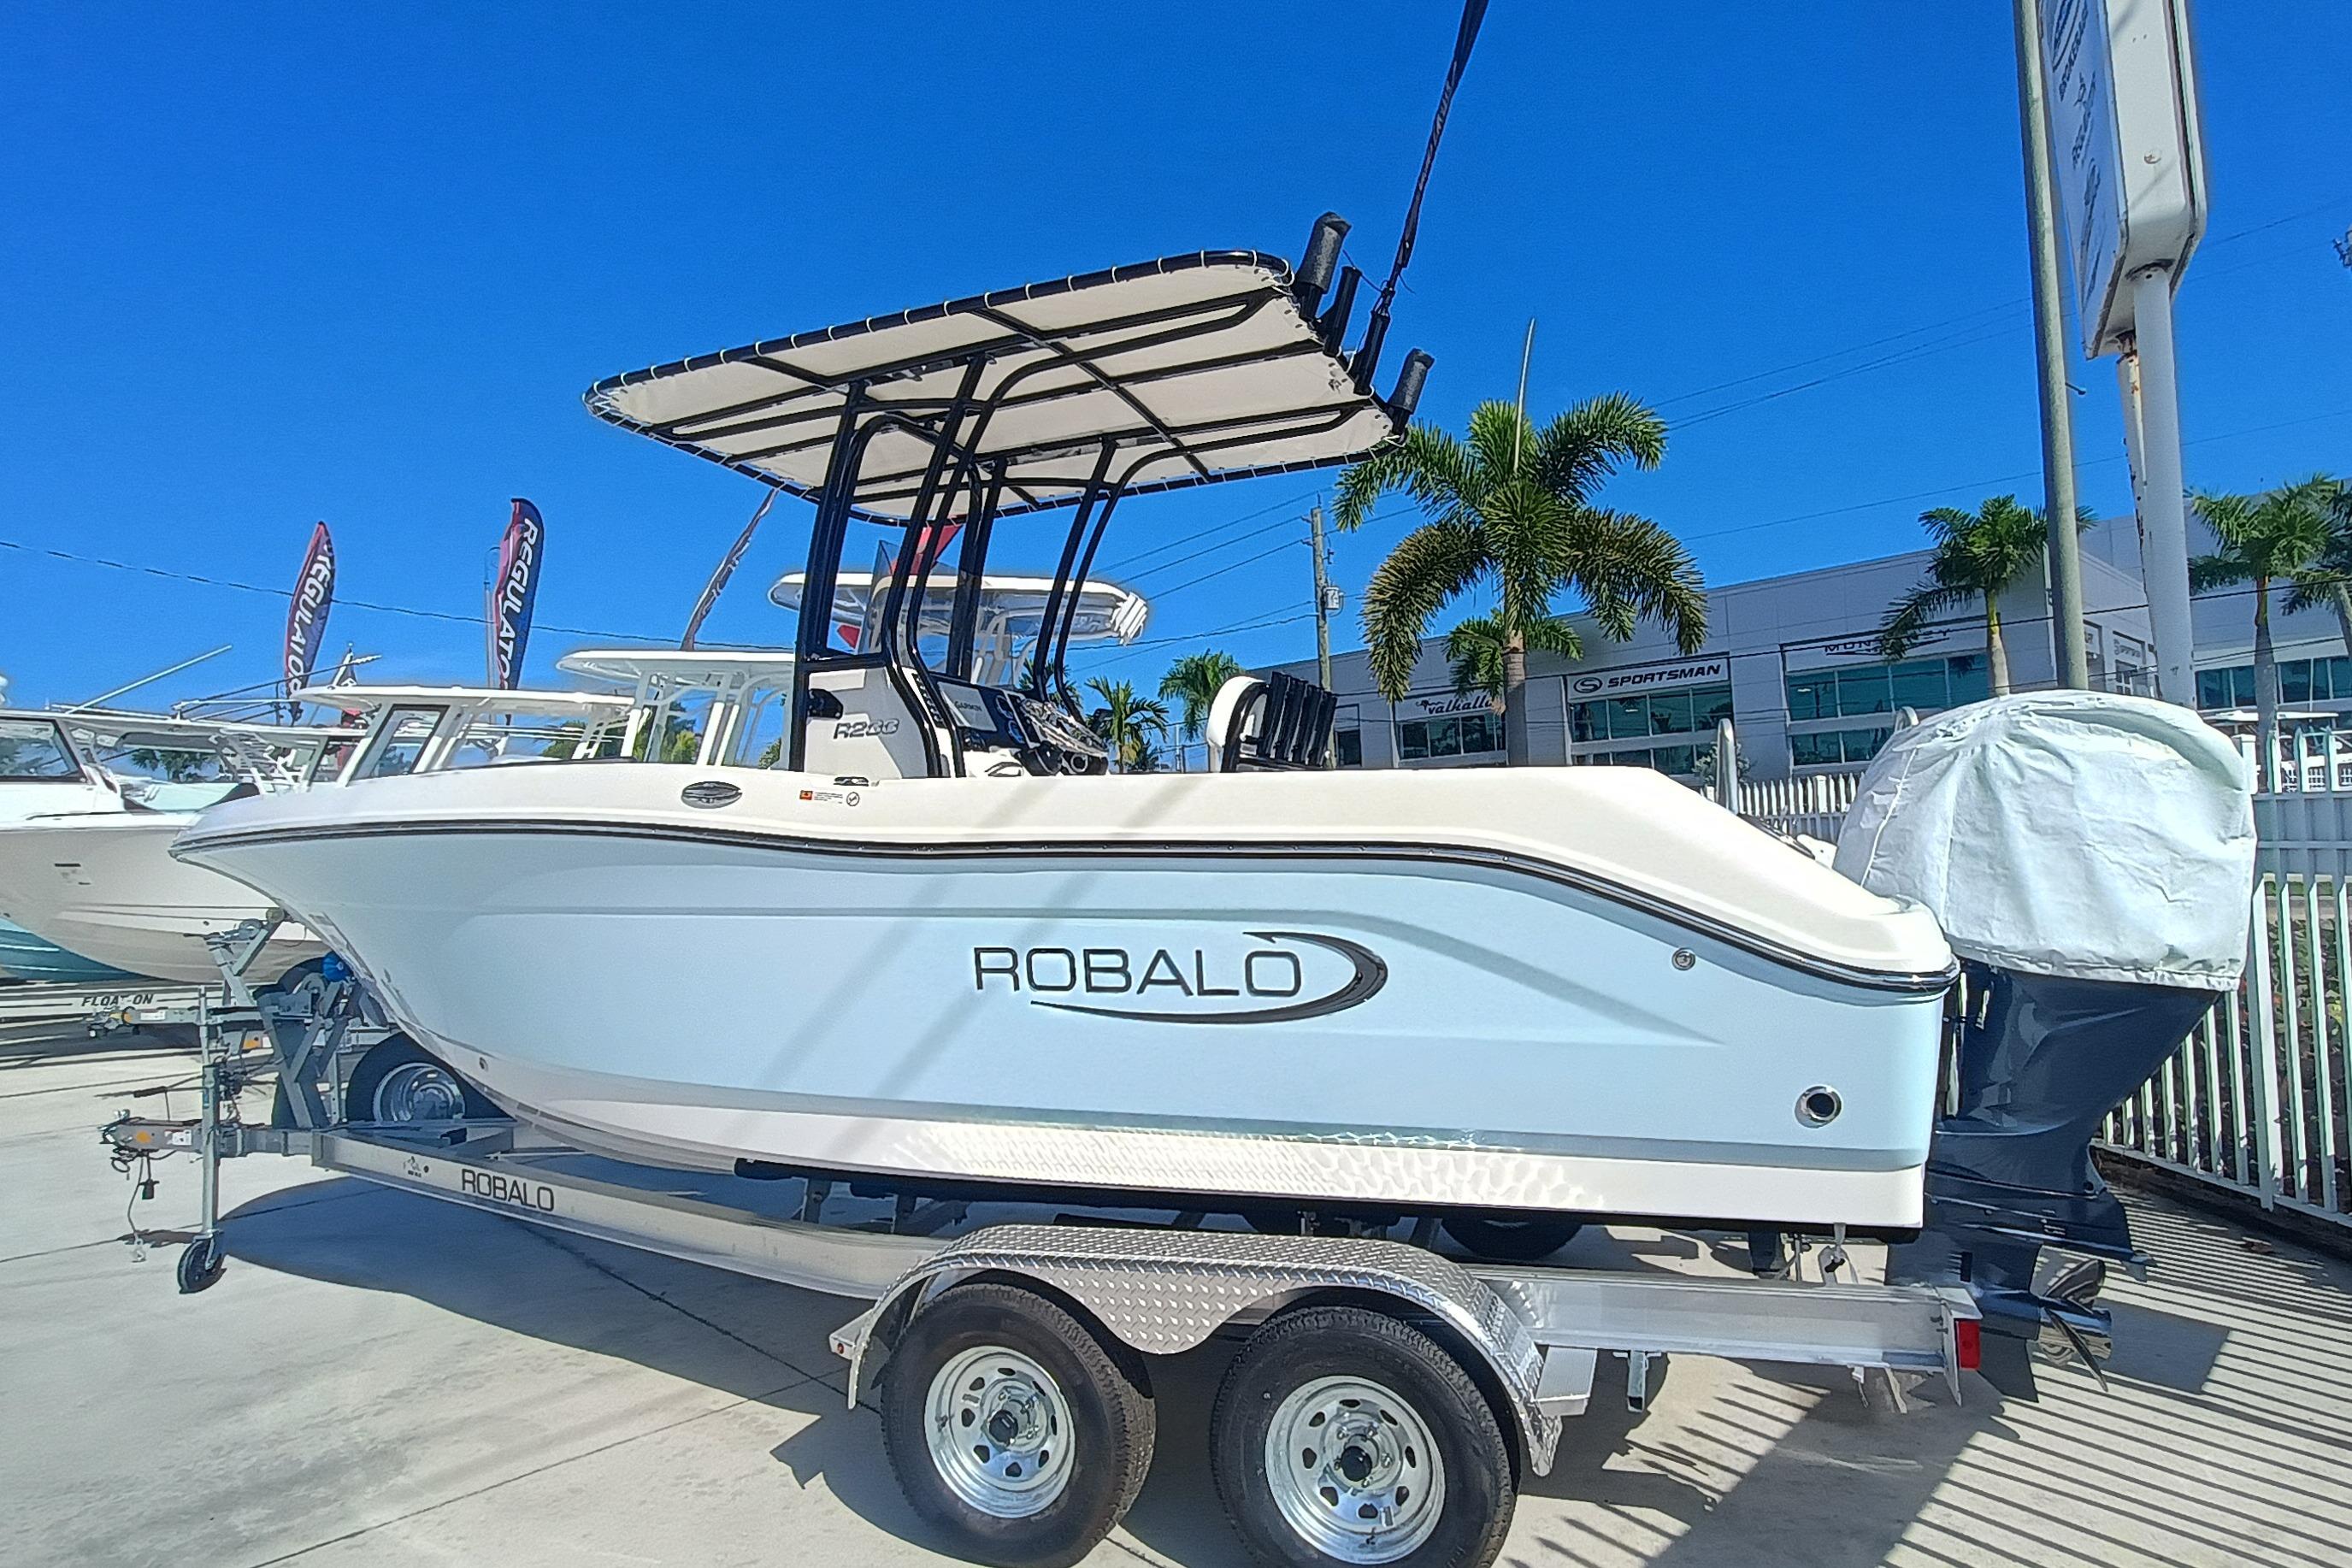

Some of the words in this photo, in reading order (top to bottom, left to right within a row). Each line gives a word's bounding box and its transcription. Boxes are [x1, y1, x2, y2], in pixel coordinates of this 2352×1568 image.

[498, 517, 539, 689] REGULATO
[1607, 664, 1721, 688] SPORTSMAN
[973, 946, 1302, 998] ROBALO
[461, 1168, 555, 1212] ROBALO
